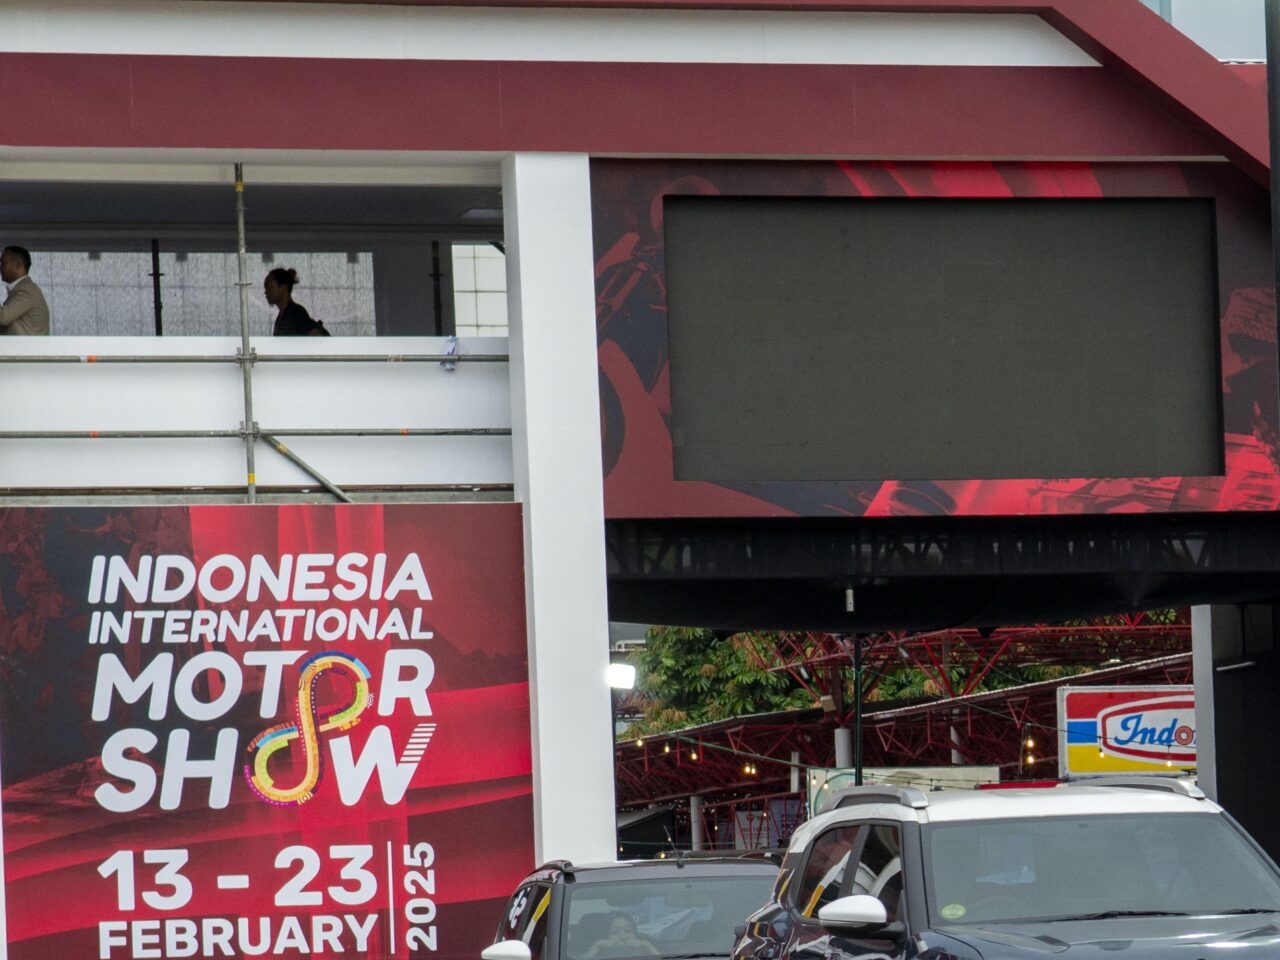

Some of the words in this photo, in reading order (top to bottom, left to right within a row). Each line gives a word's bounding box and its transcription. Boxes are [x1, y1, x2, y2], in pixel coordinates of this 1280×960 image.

[88, 552, 434, 604] INDONESIA
[88, 607, 434, 644] INTERNATIONAL
[91, 648, 436, 722] MOTOR
[1114, 713, 1197, 746] Indo
[97, 849, 193, 911] 13
[217, 874, 249, 889] -
[274, 845, 378, 906] 23
[403, 841, 438, 951] 2025
[99, 914, 379, 960] FEBRUARY
